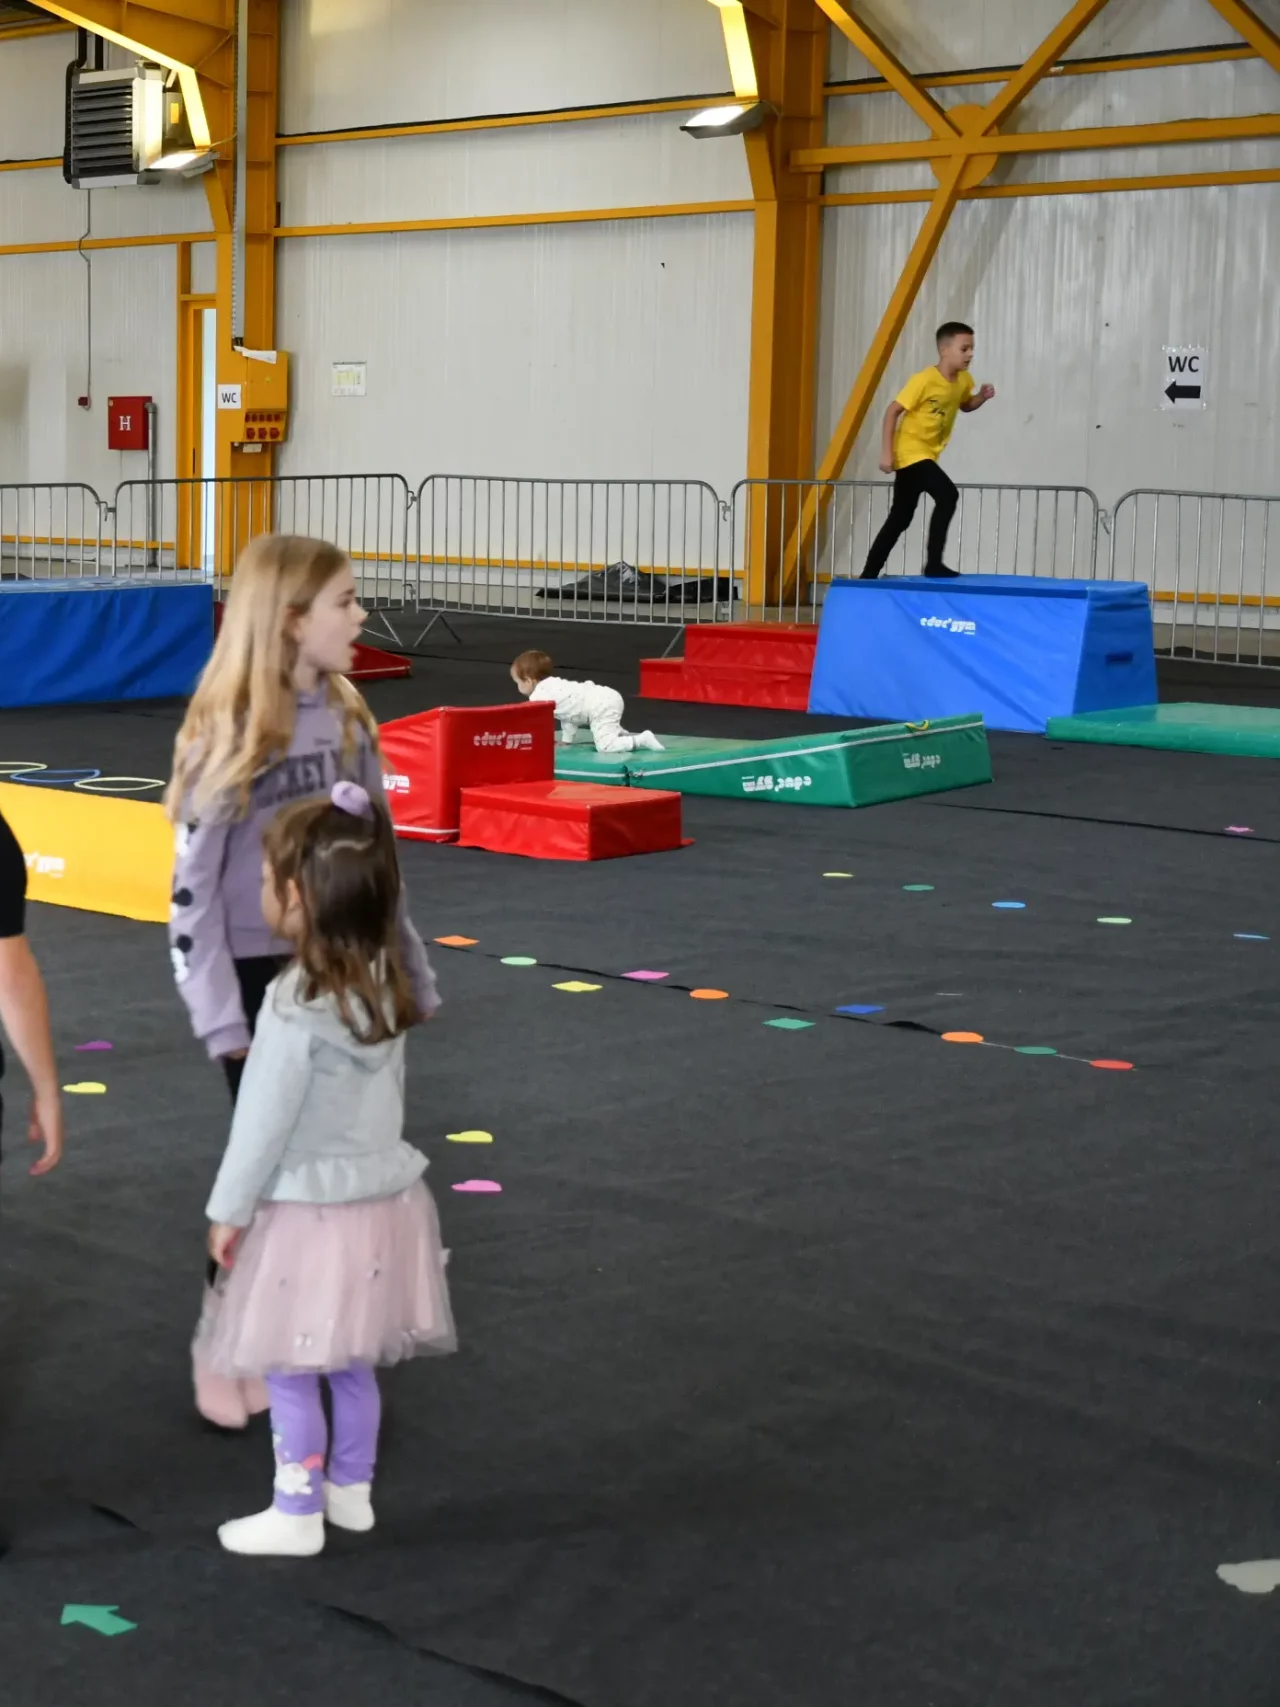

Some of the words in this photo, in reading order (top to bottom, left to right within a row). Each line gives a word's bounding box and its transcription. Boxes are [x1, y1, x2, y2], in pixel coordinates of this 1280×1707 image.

[1168, 356, 1200, 373] WC
[222, 393, 237, 403] WC
[119, 416, 131, 431] H
[920, 616, 976, 632] educ'gym
[473, 731, 532, 750] educ'gym
